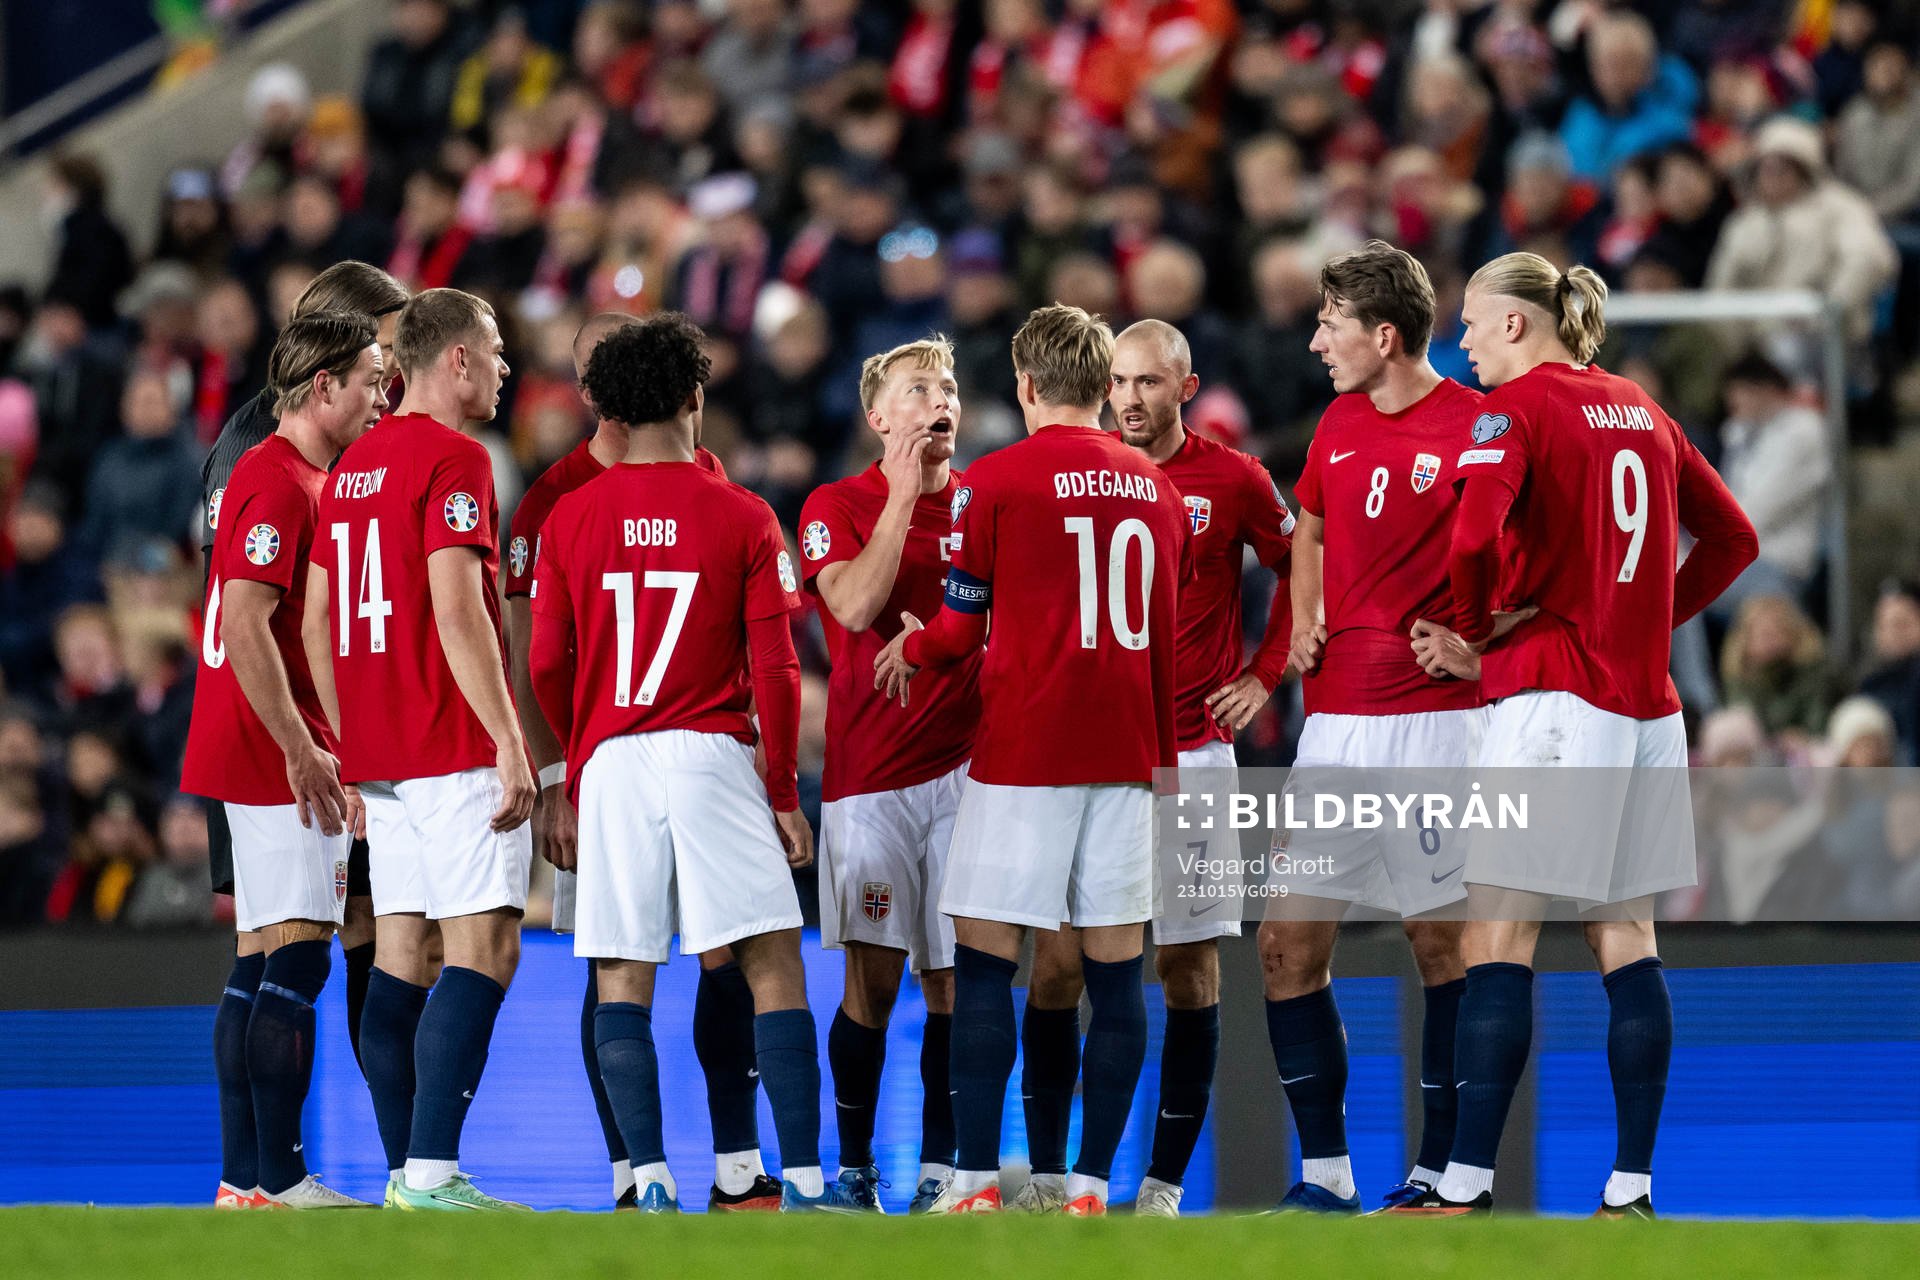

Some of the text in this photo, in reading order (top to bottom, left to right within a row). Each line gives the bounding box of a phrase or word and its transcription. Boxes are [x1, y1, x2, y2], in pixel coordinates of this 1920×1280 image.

[1582, 404, 1654, 431] HAALAND
[334, 467, 387, 499] RYERSON
[1054, 469, 1158, 503] ØDEGAARD
[1365, 467, 1389, 519] 8
[623, 518, 677, 547] BOBB
[1611, 449, 1648, 583] 9
[331, 518, 392, 656] 14
[1064, 516, 1155, 651] 10
[602, 570, 700, 708] 17
